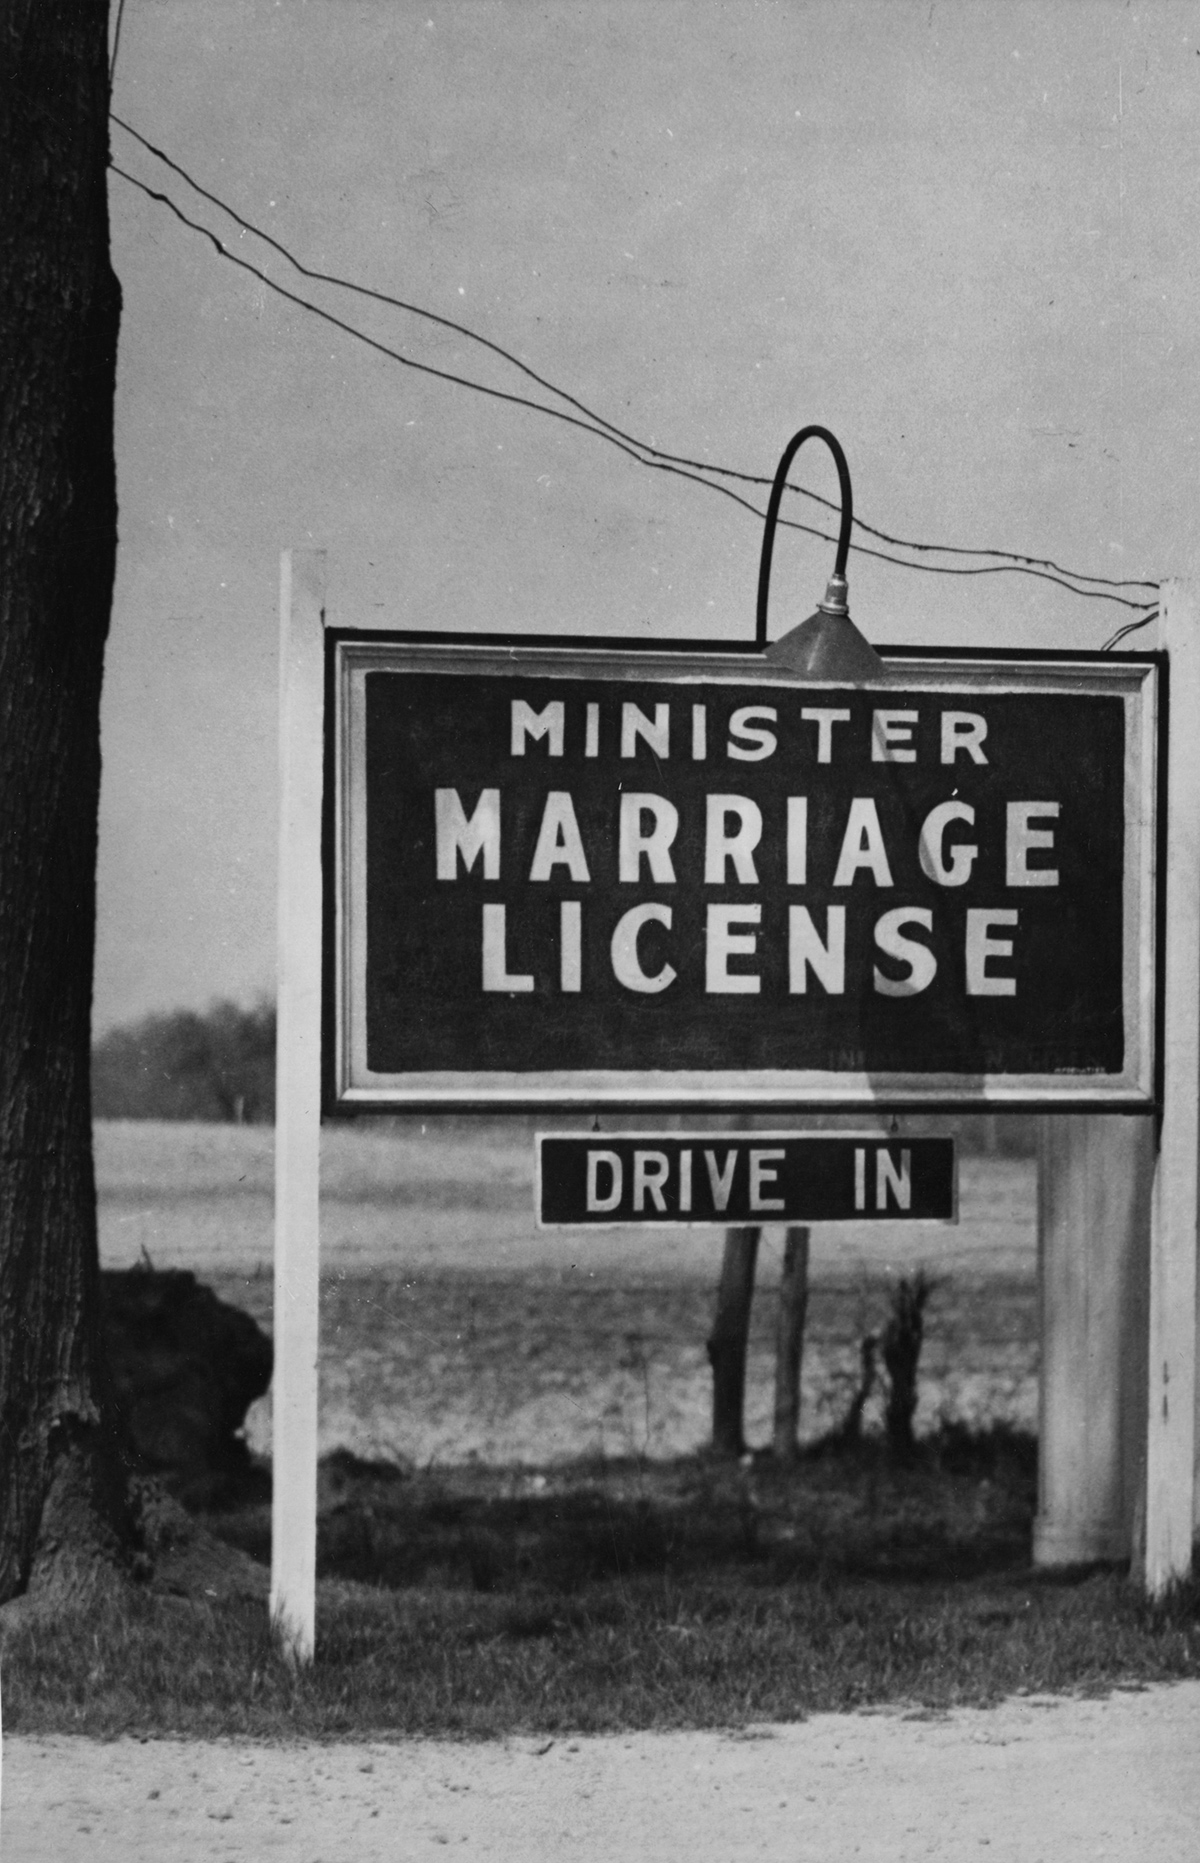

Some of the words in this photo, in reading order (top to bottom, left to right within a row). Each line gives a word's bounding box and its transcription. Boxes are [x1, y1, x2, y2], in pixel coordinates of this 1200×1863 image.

[510, 699, 989, 765] MINISTER
[434, 788, 1060, 888] MARRIAGE
[482, 901, 1019, 997] LICENSE
[586, 1149, 786, 1212] DRIVE
[854, 1148, 912, 1210] IN
